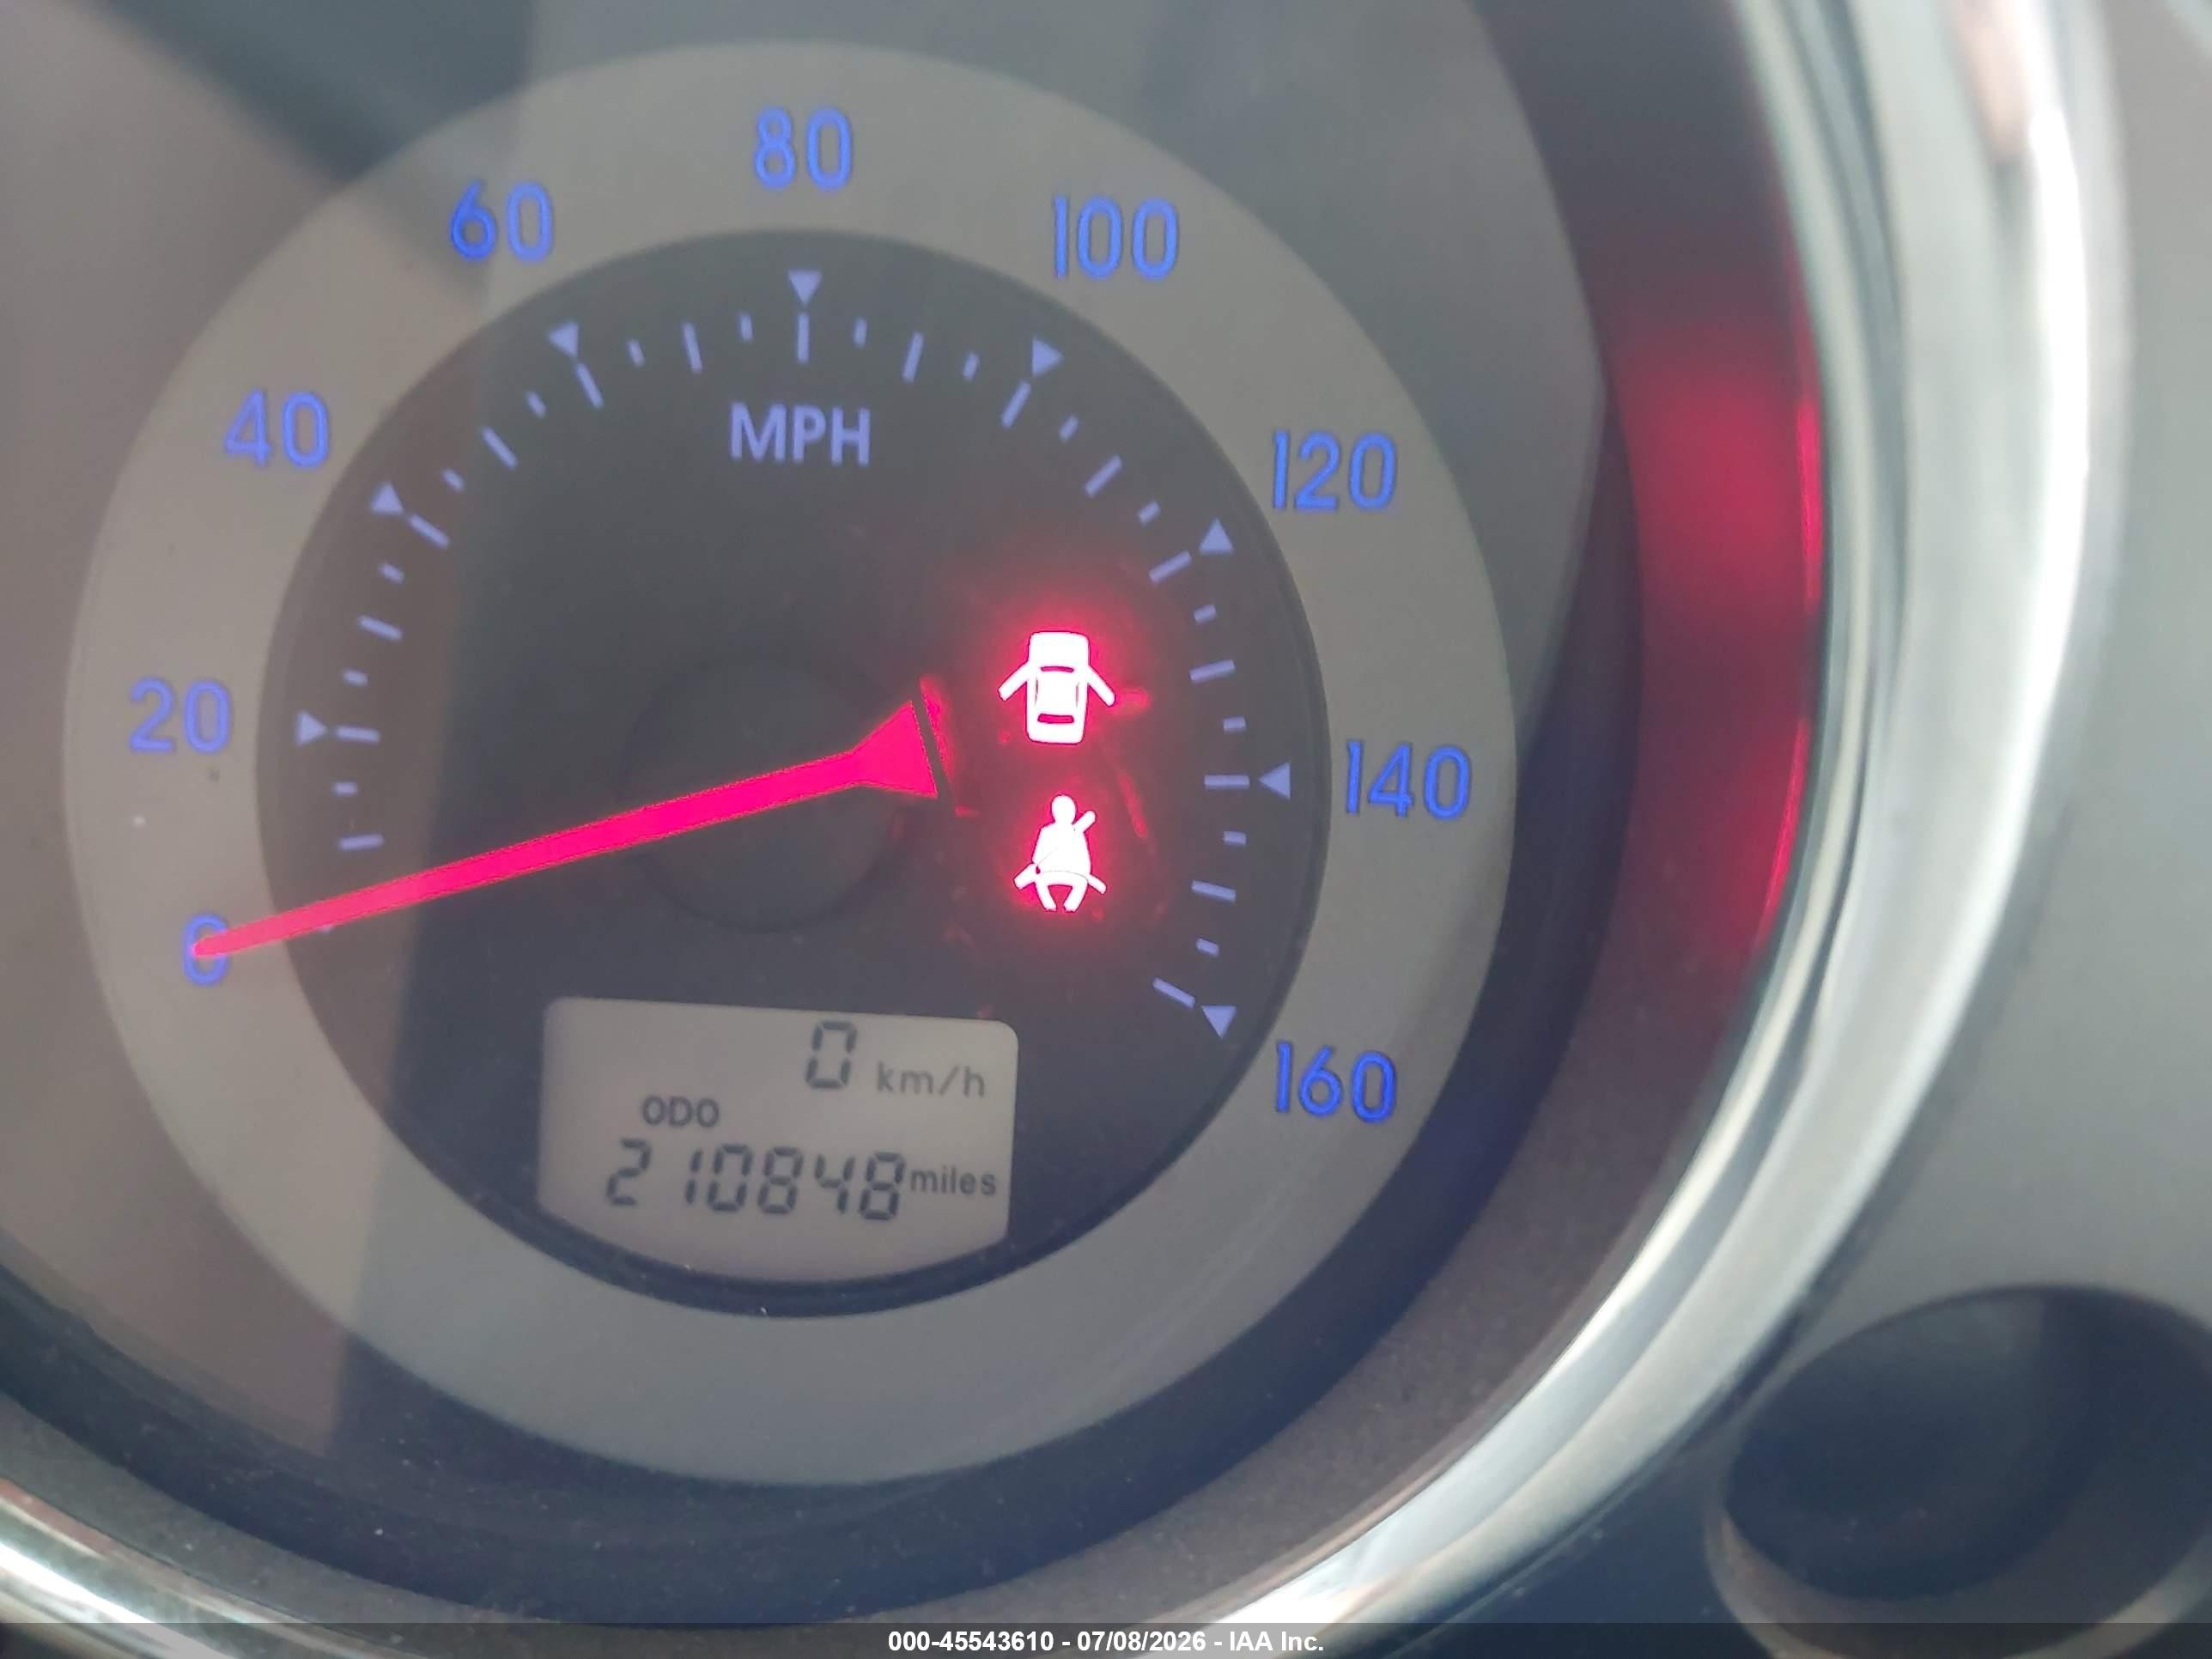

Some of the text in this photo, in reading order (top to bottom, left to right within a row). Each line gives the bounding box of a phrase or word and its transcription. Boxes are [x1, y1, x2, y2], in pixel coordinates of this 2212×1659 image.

[754, 105, 853, 191] 80
[449, 181, 554, 260] 60
[1053, 194, 1180, 280] 100
[224, 392, 330, 468] 40
[730, 403, 872, 465] MPH
[1273, 430, 1397, 511] 120
[129, 678, 230, 752] 20
[1347, 740, 1472, 819] 140
[805, 1020, 987, 1098] 0 km/h
[1276, 1042, 1398, 1124] 160
[641, 1095, 720, 1128] ODO
[605, 1138, 997, 1220] 210848 miles
